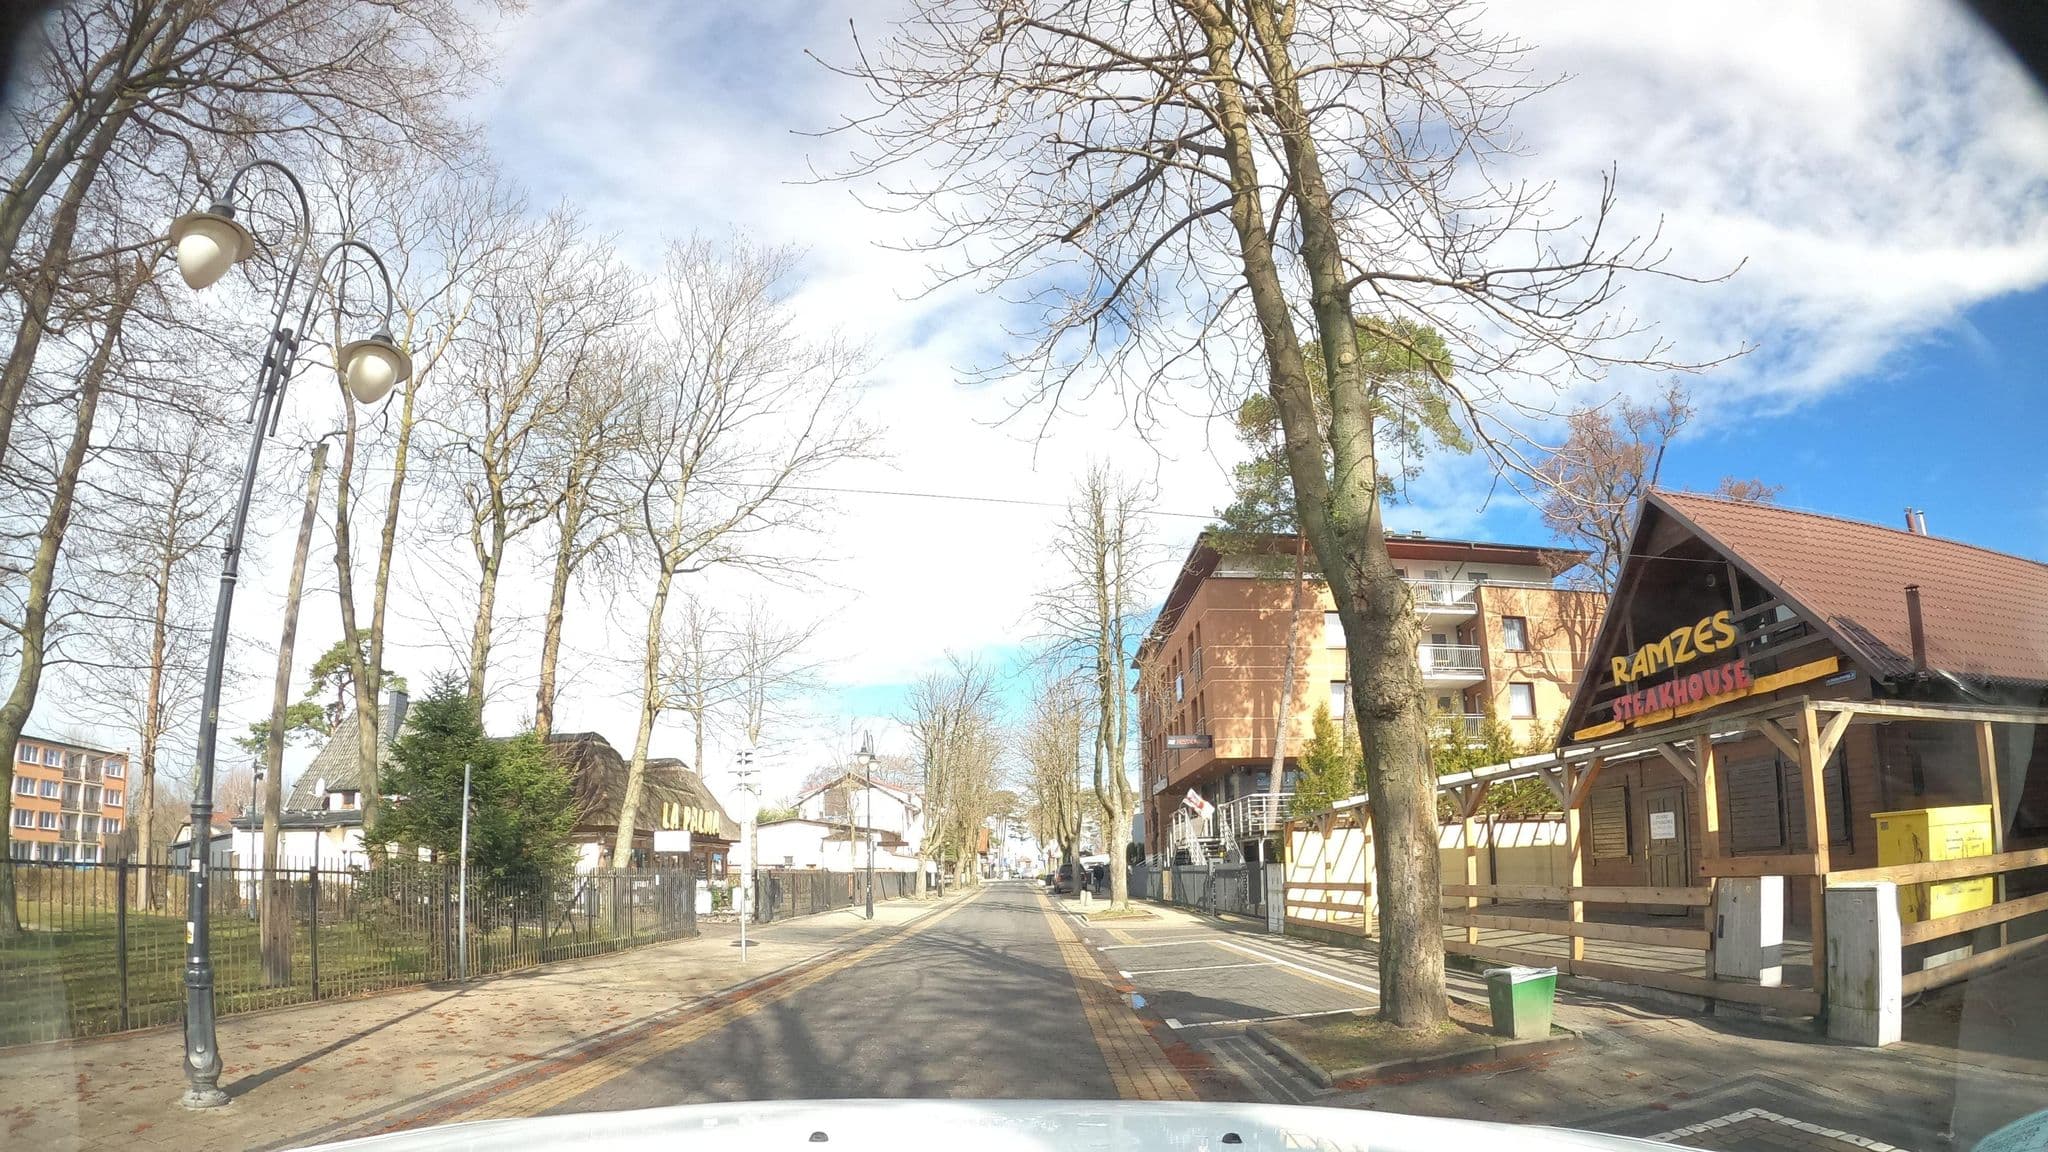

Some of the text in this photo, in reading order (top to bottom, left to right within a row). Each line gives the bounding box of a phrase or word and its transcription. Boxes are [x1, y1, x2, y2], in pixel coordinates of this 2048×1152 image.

[1611, 610, 1736, 687] RAMZES
[1612, 659, 1751, 721] STEAKHOUSE
[662, 801, 720, 836] LA PALMA
